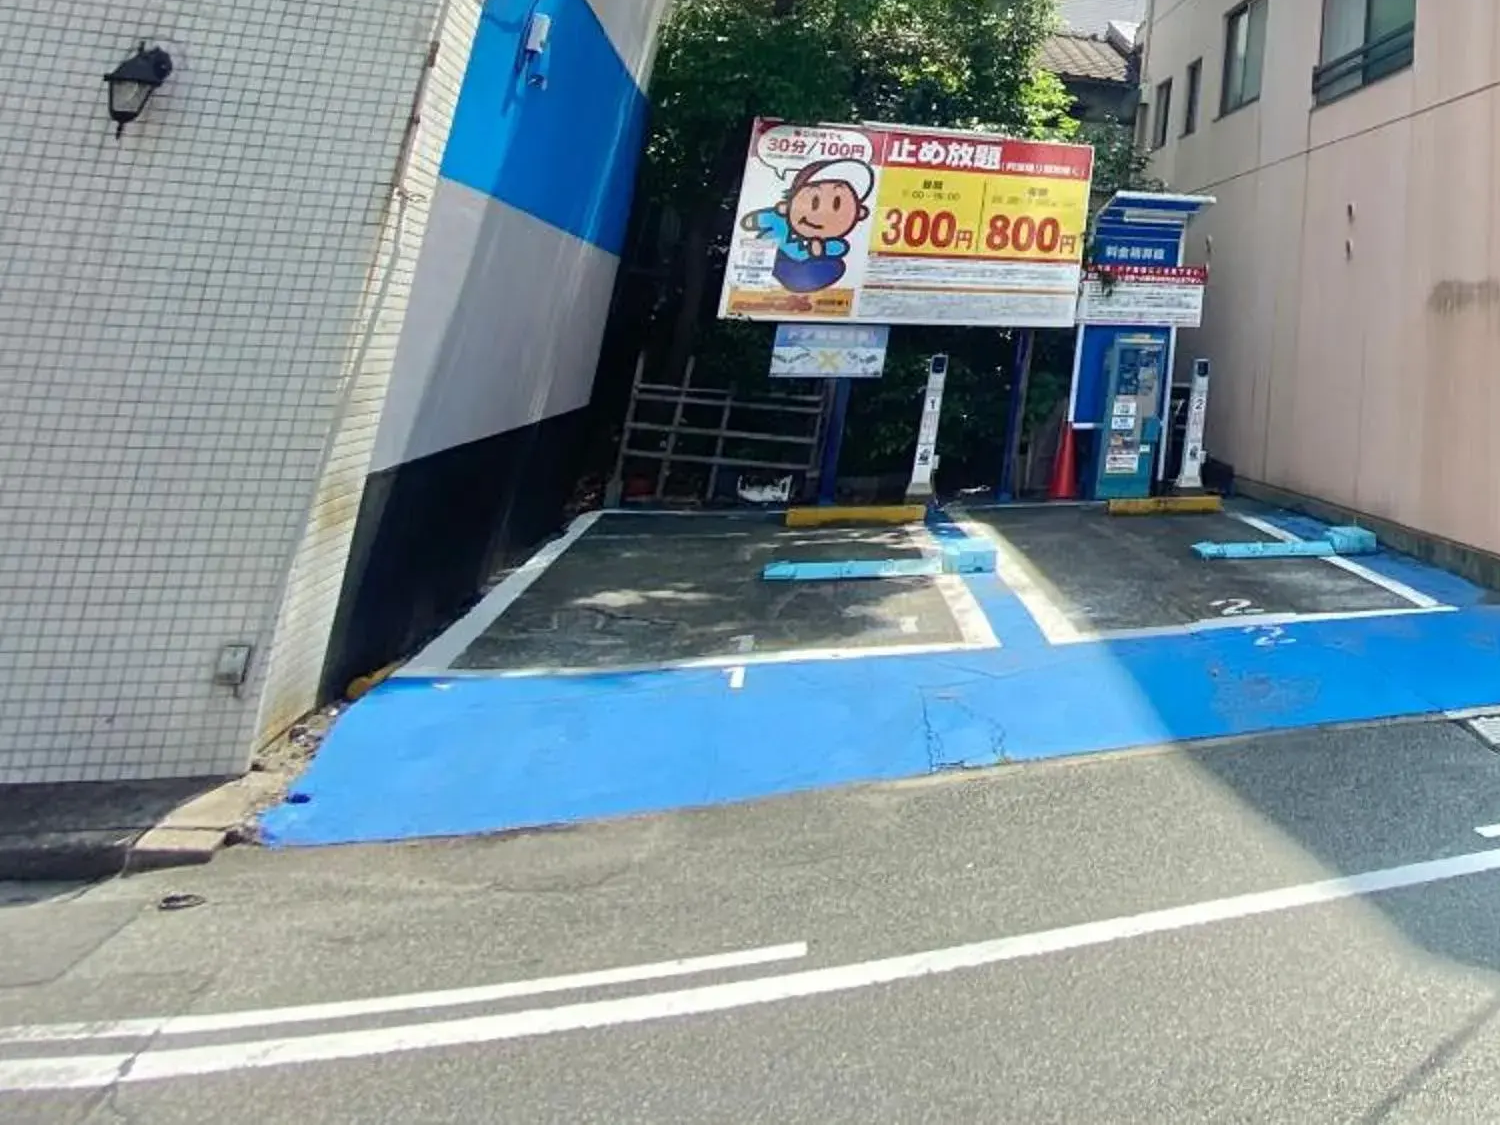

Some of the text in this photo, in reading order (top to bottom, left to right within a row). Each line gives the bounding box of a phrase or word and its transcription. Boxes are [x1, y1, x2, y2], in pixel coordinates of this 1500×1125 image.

[766, 137, 865, 158] 30分/100円
[887, 138, 1003, 170] 止め放題
[881, 208, 974, 250] 300円
[985, 214, 1077, 254] 800円
